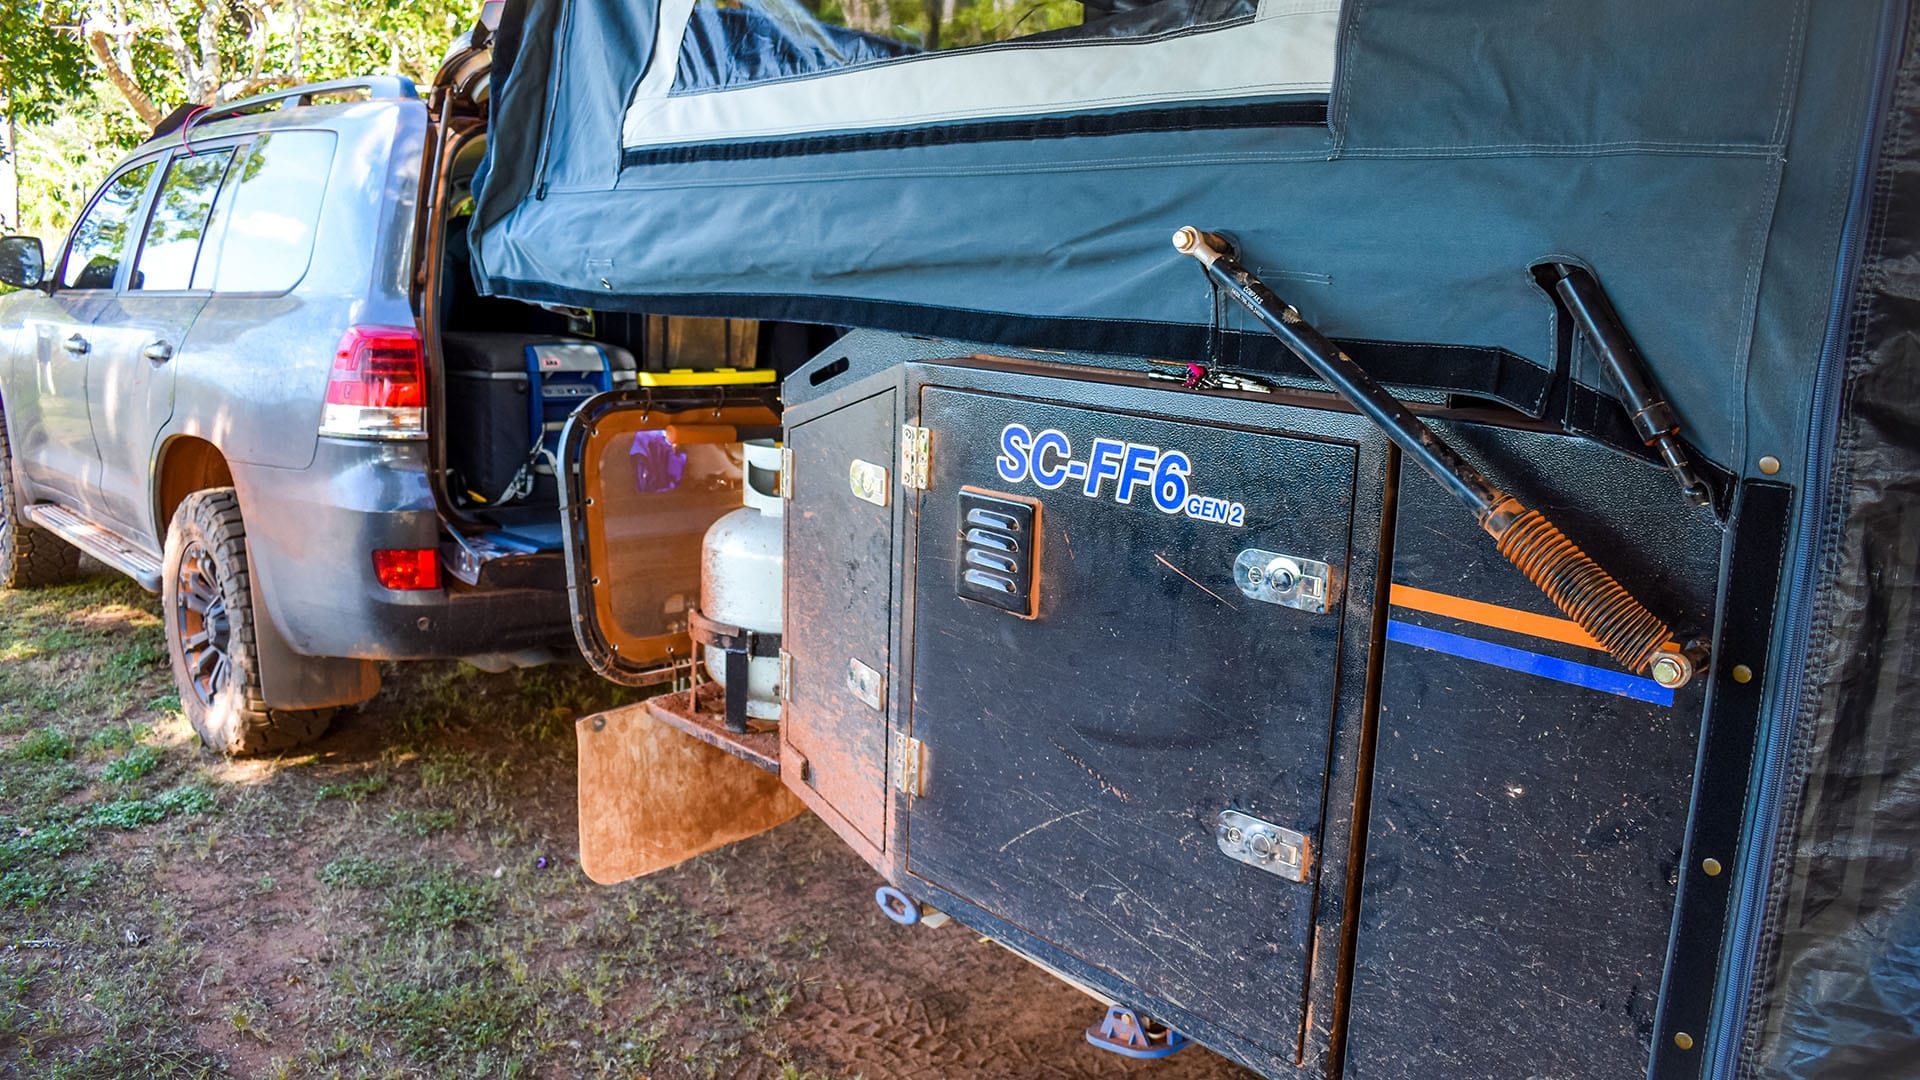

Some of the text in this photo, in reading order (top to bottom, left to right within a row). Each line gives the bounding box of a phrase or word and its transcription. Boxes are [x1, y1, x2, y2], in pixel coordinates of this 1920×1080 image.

[997, 424, 1243, 524] SC-FF6 GEN 2
